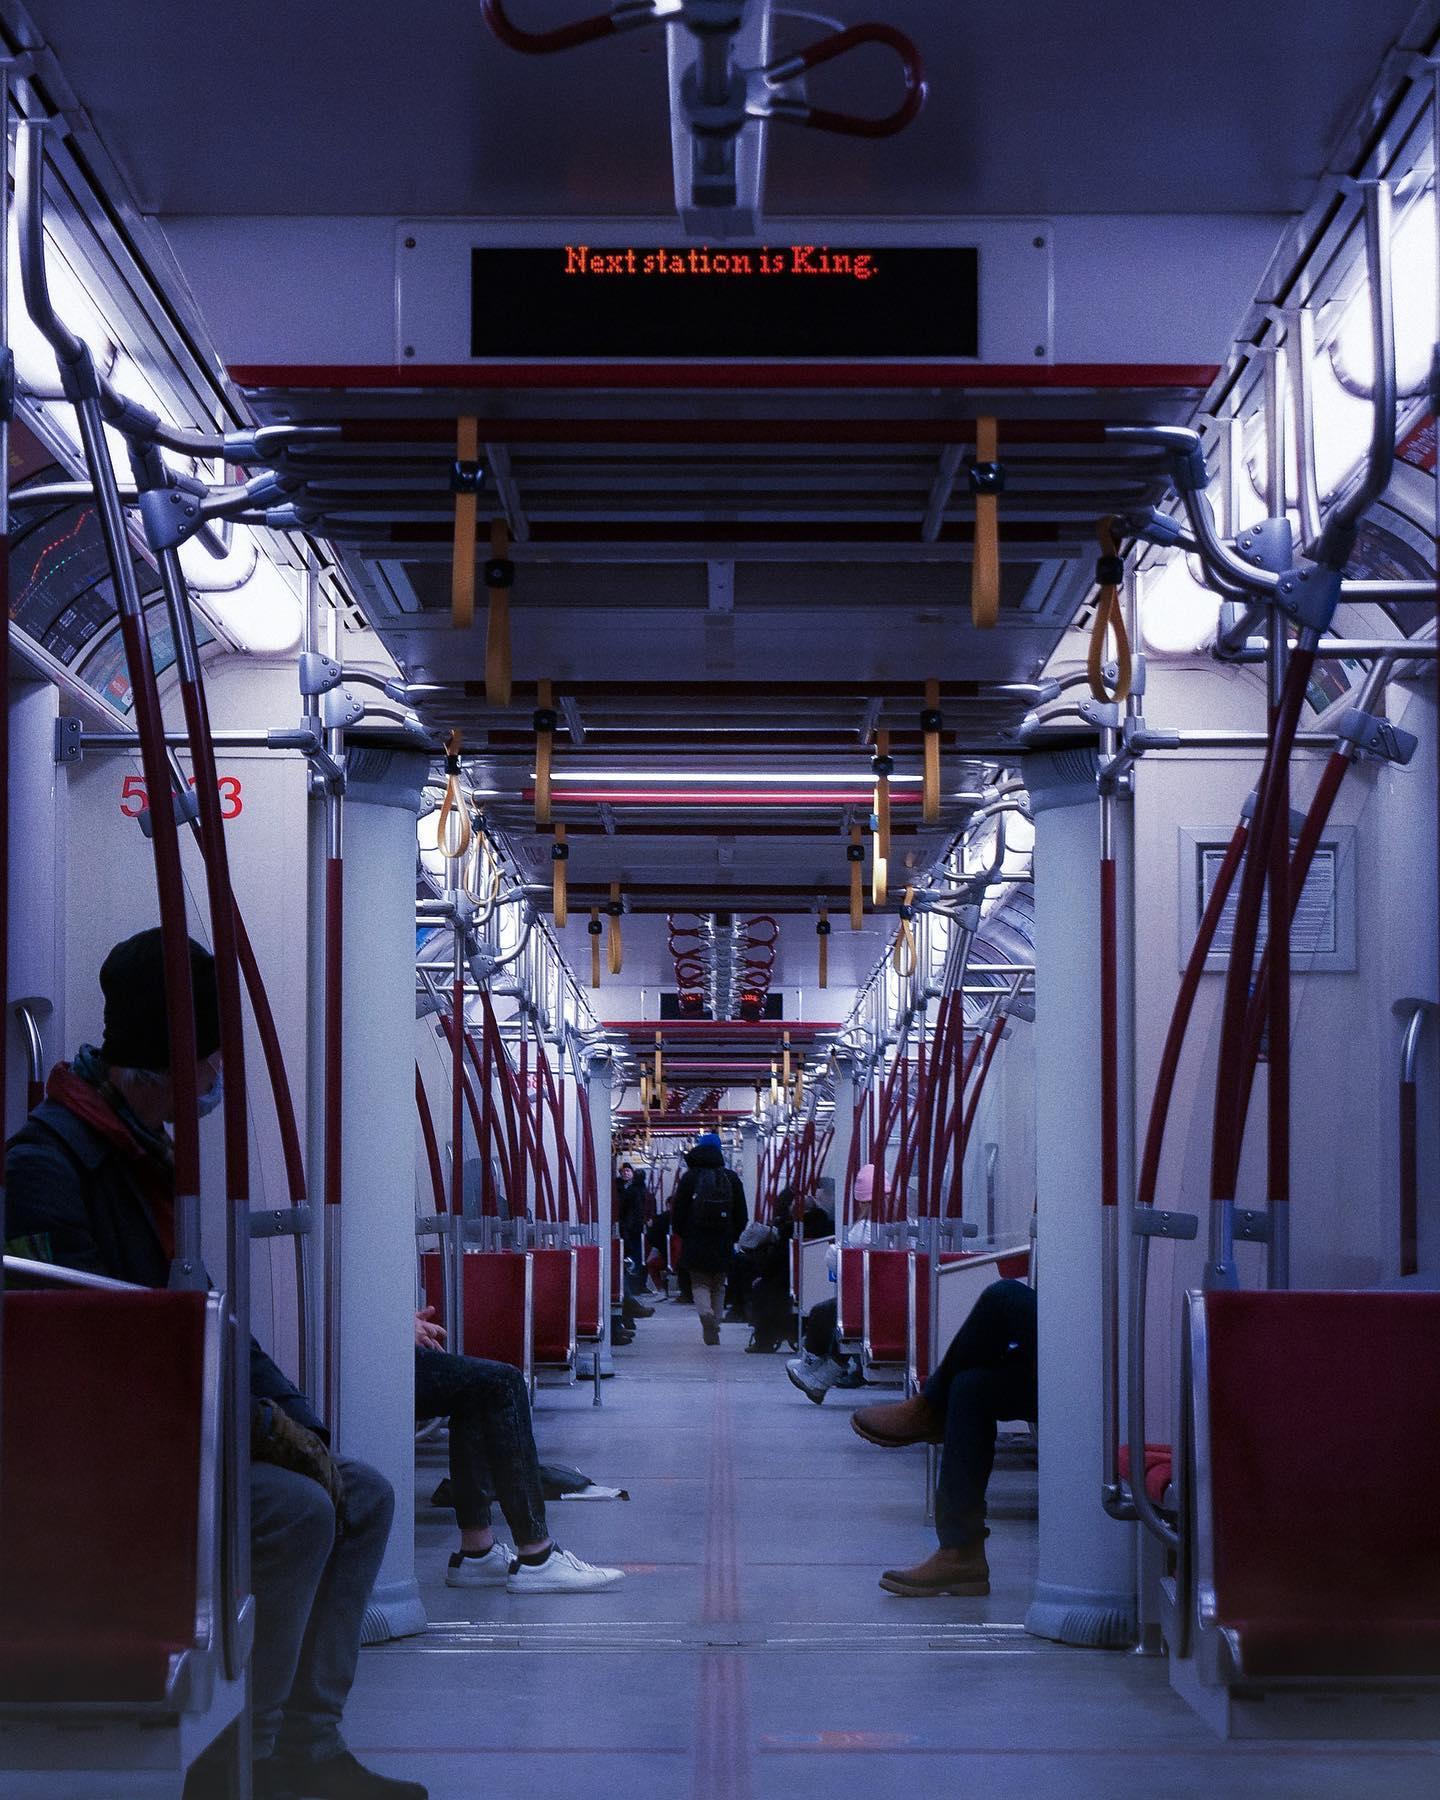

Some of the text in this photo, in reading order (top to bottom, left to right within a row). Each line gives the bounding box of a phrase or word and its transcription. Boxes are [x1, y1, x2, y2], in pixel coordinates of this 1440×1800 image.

[564, 245, 879, 279] Next station is King.
[120, 775, 243, 819] 53
